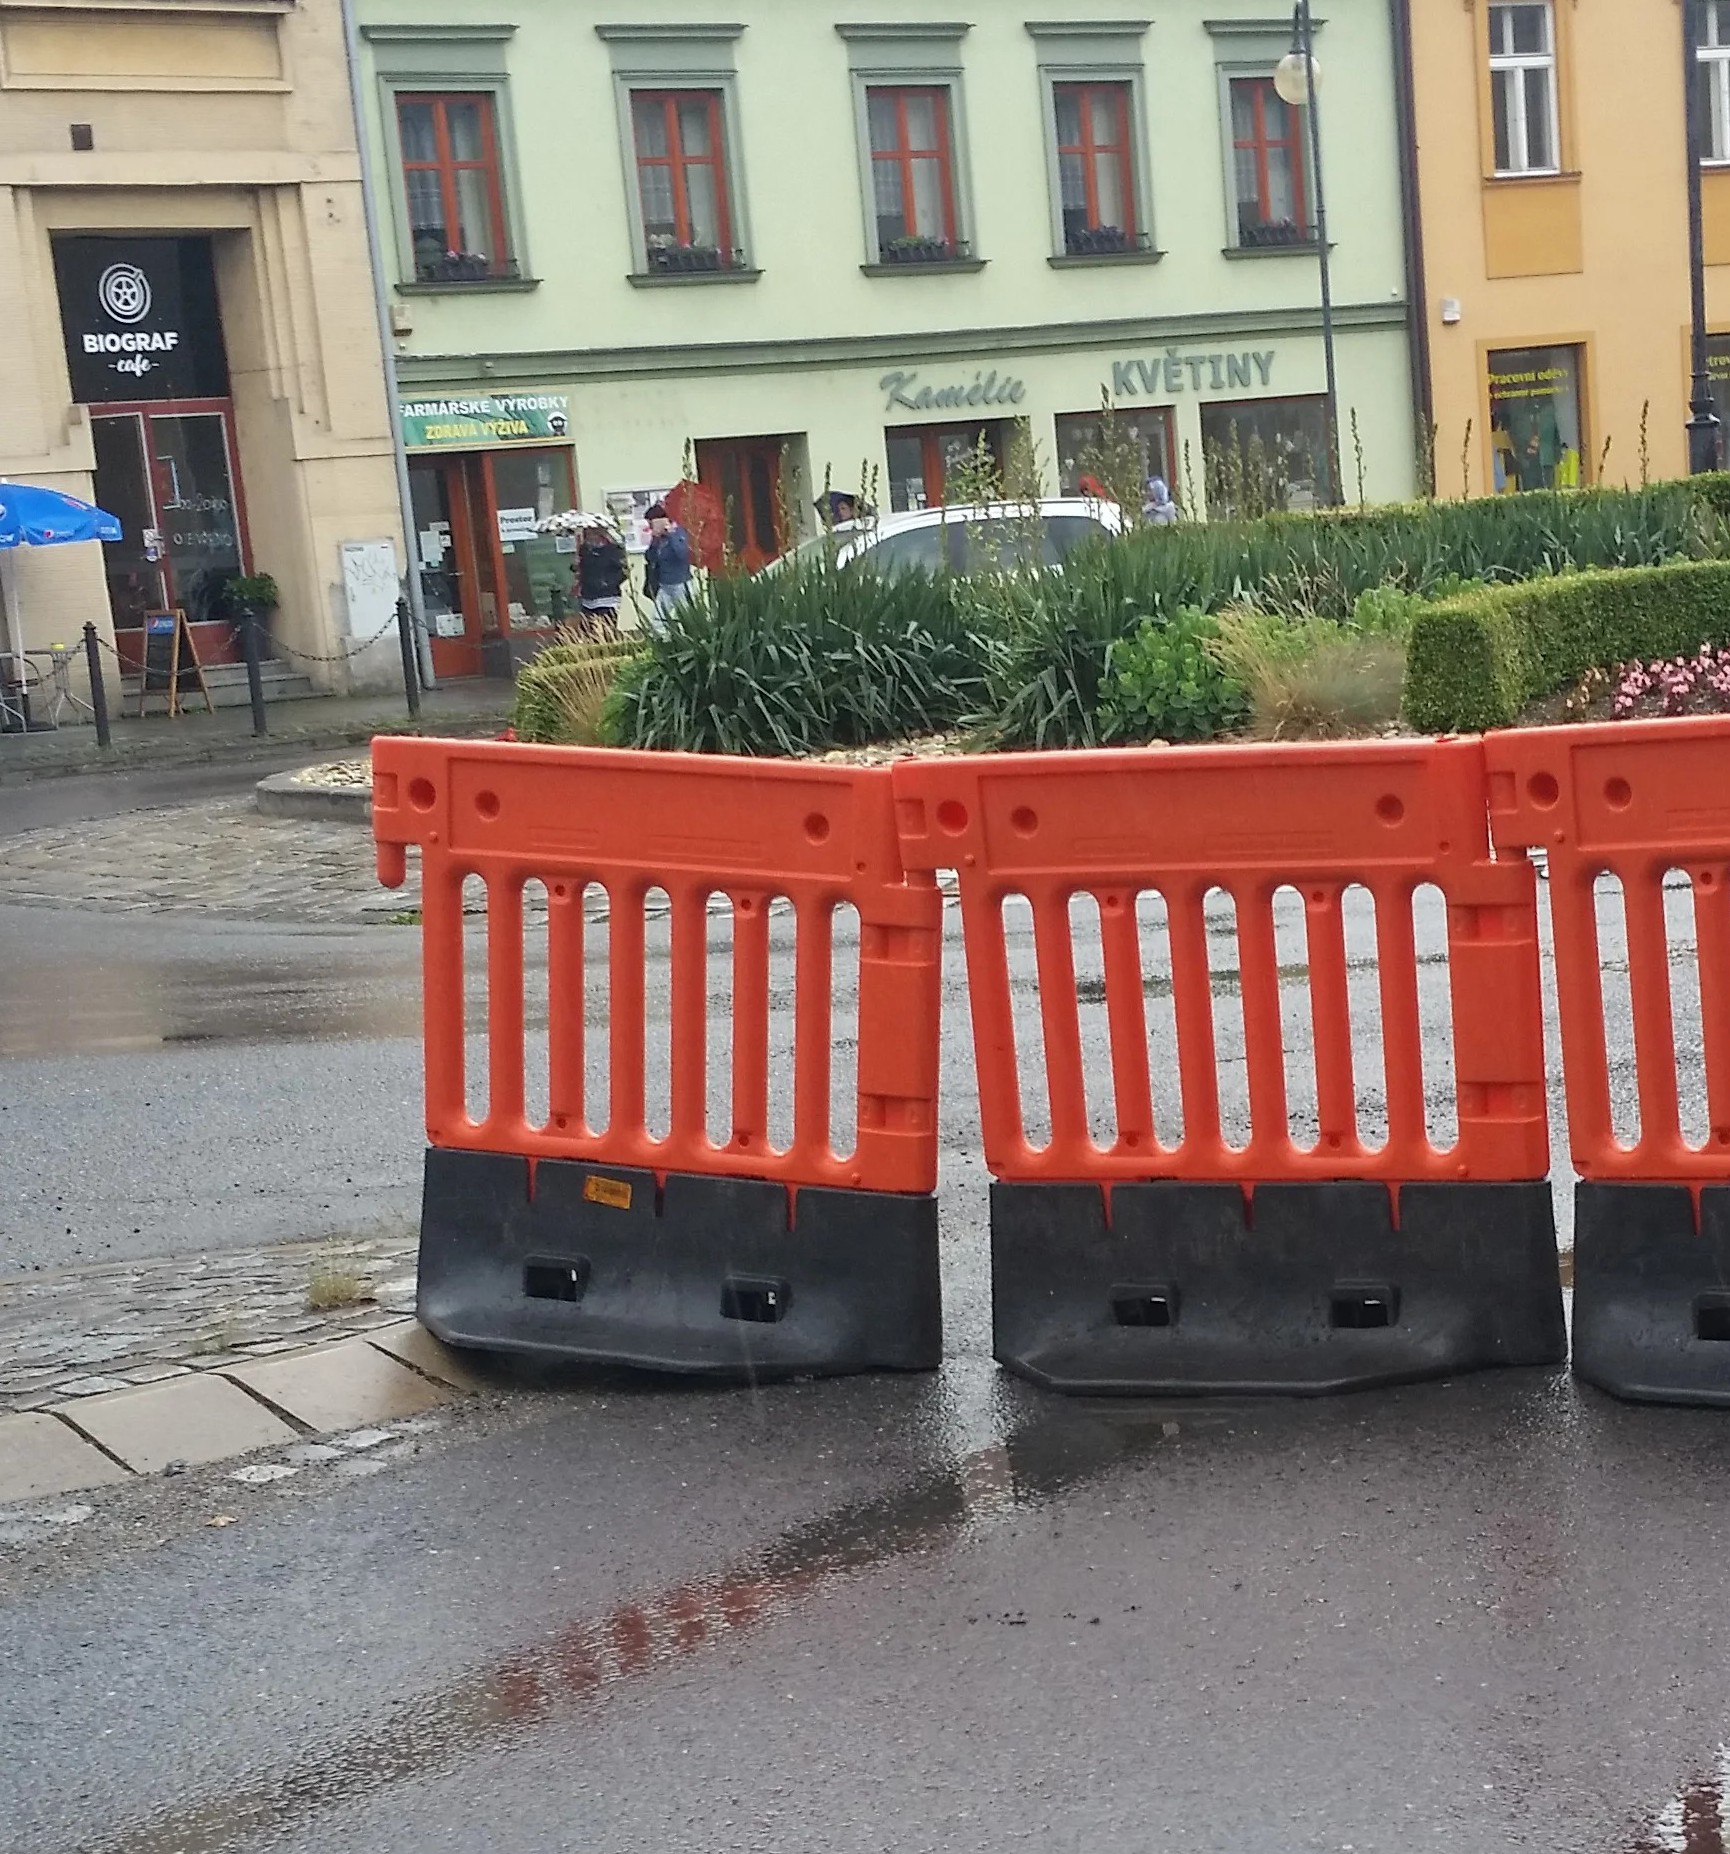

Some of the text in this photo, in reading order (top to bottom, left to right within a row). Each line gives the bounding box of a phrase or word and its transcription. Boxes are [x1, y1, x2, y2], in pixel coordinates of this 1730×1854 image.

[82, 332, 179, 353] BIOGRAF
[1112, 347, 1275, 396] KVĚTINY
[495, 395, 568, 412] VÝROBKY
[880, 369, 1026, 412] Kamélie
